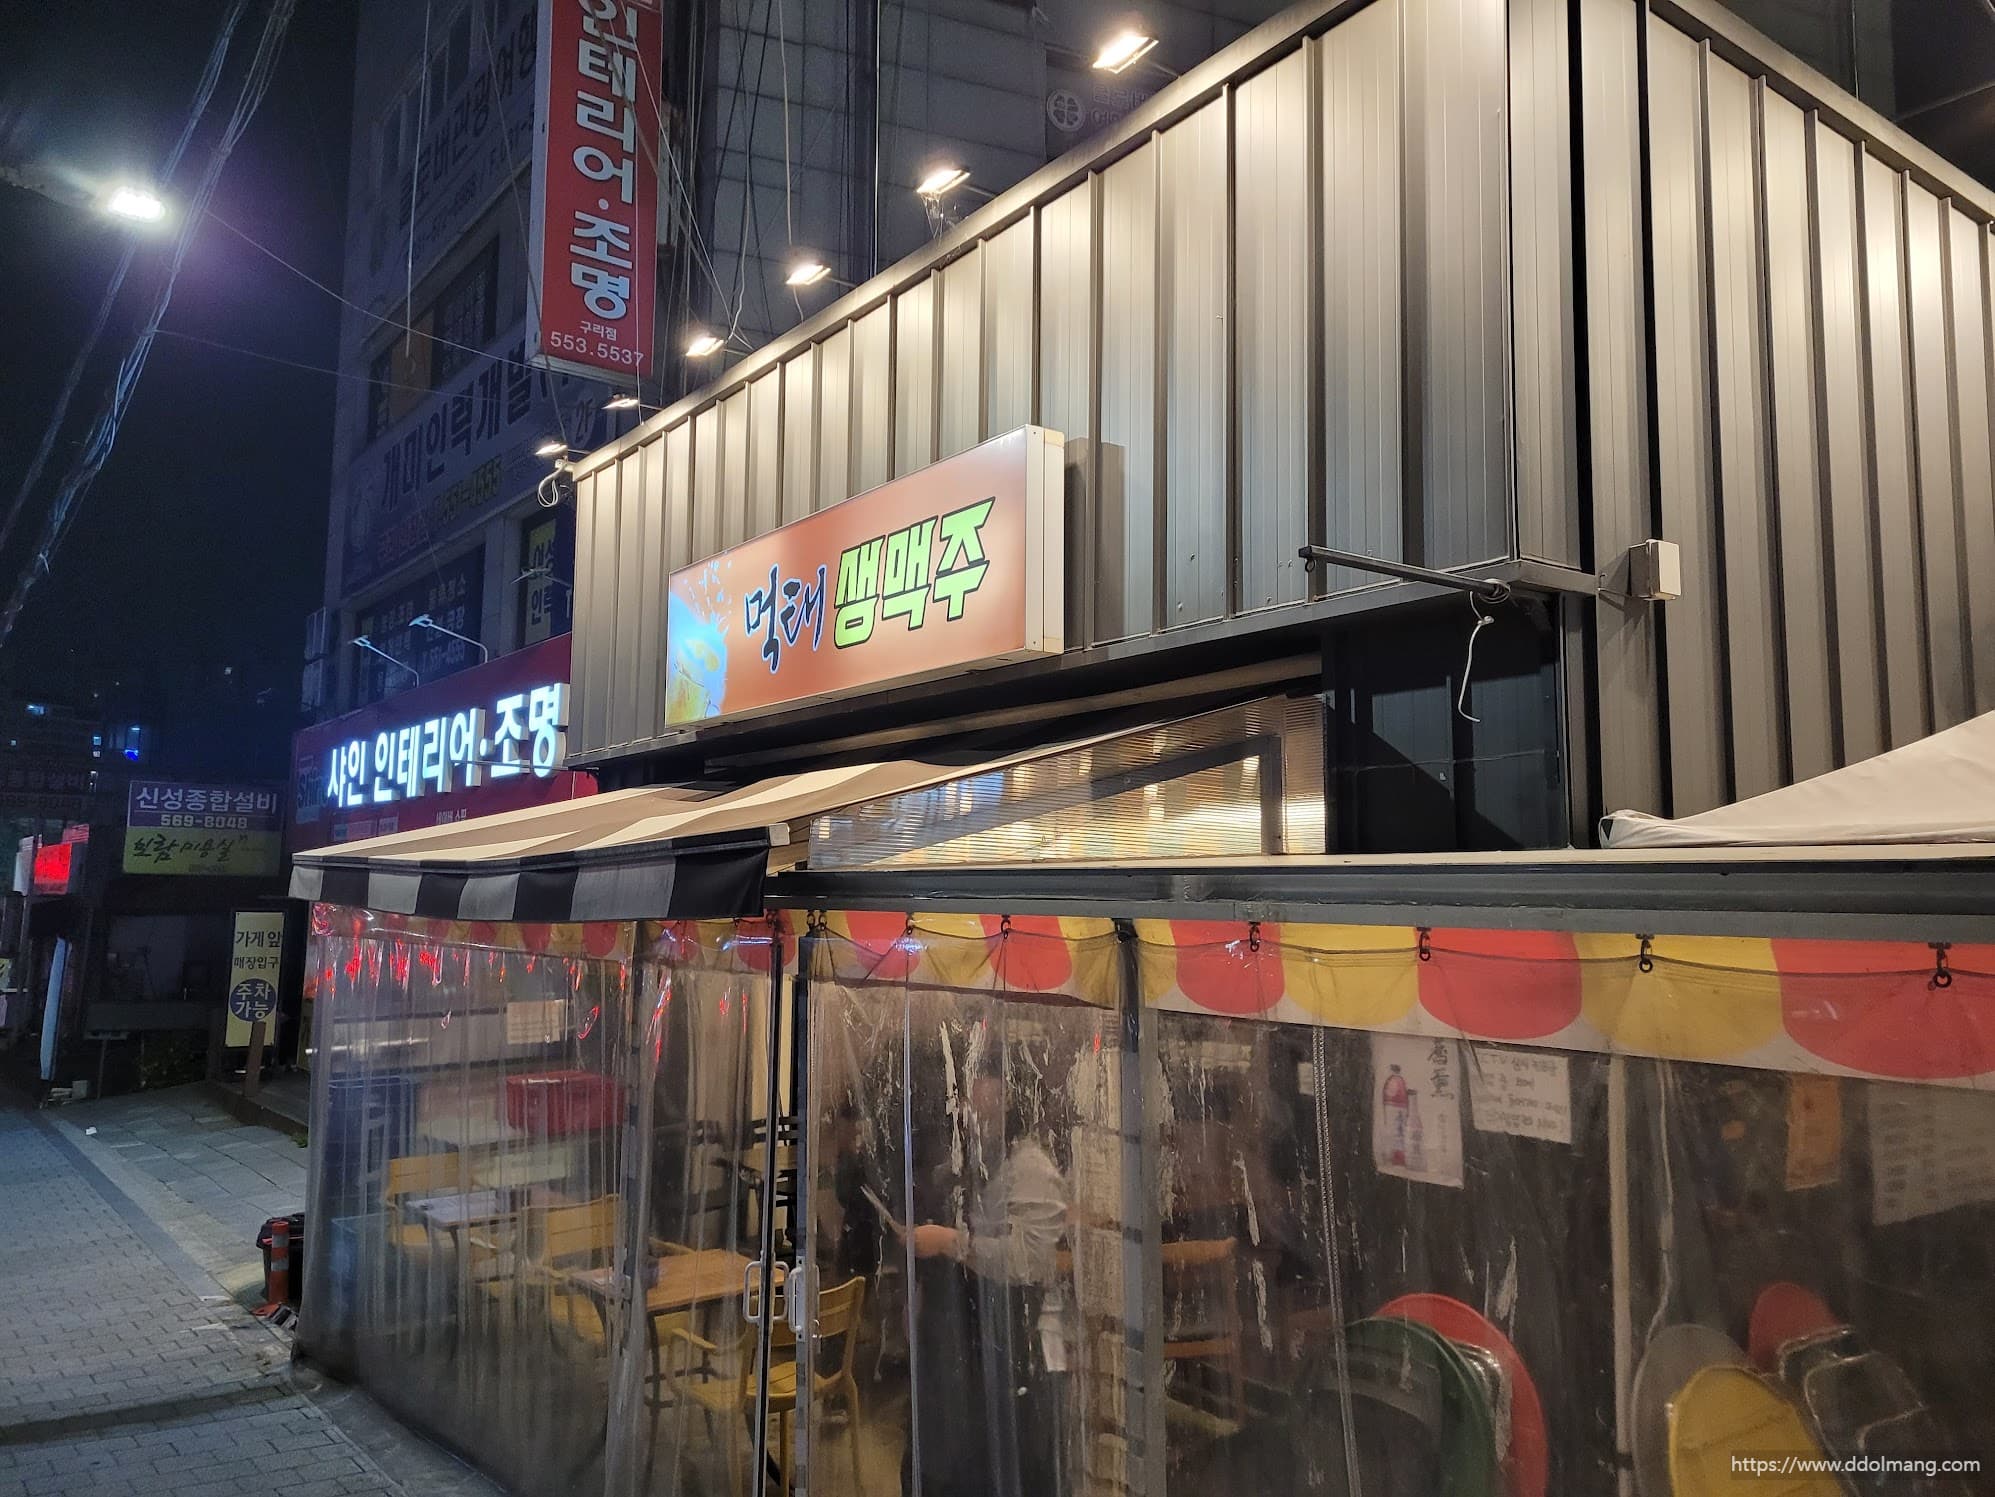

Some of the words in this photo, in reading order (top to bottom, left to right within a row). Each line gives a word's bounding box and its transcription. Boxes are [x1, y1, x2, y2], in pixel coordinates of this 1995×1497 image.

[580, 320, 617, 341] 구리점
[550, 331, 644, 367] 553.5537
[833, 496, 996, 650] 생맥주
[136, 786, 278, 814] 신성종합설비
[160, 814, 249, 829] 569-8048
[236, 982, 271, 1001] 주차
[235, 1001, 269, 1019] 가능
